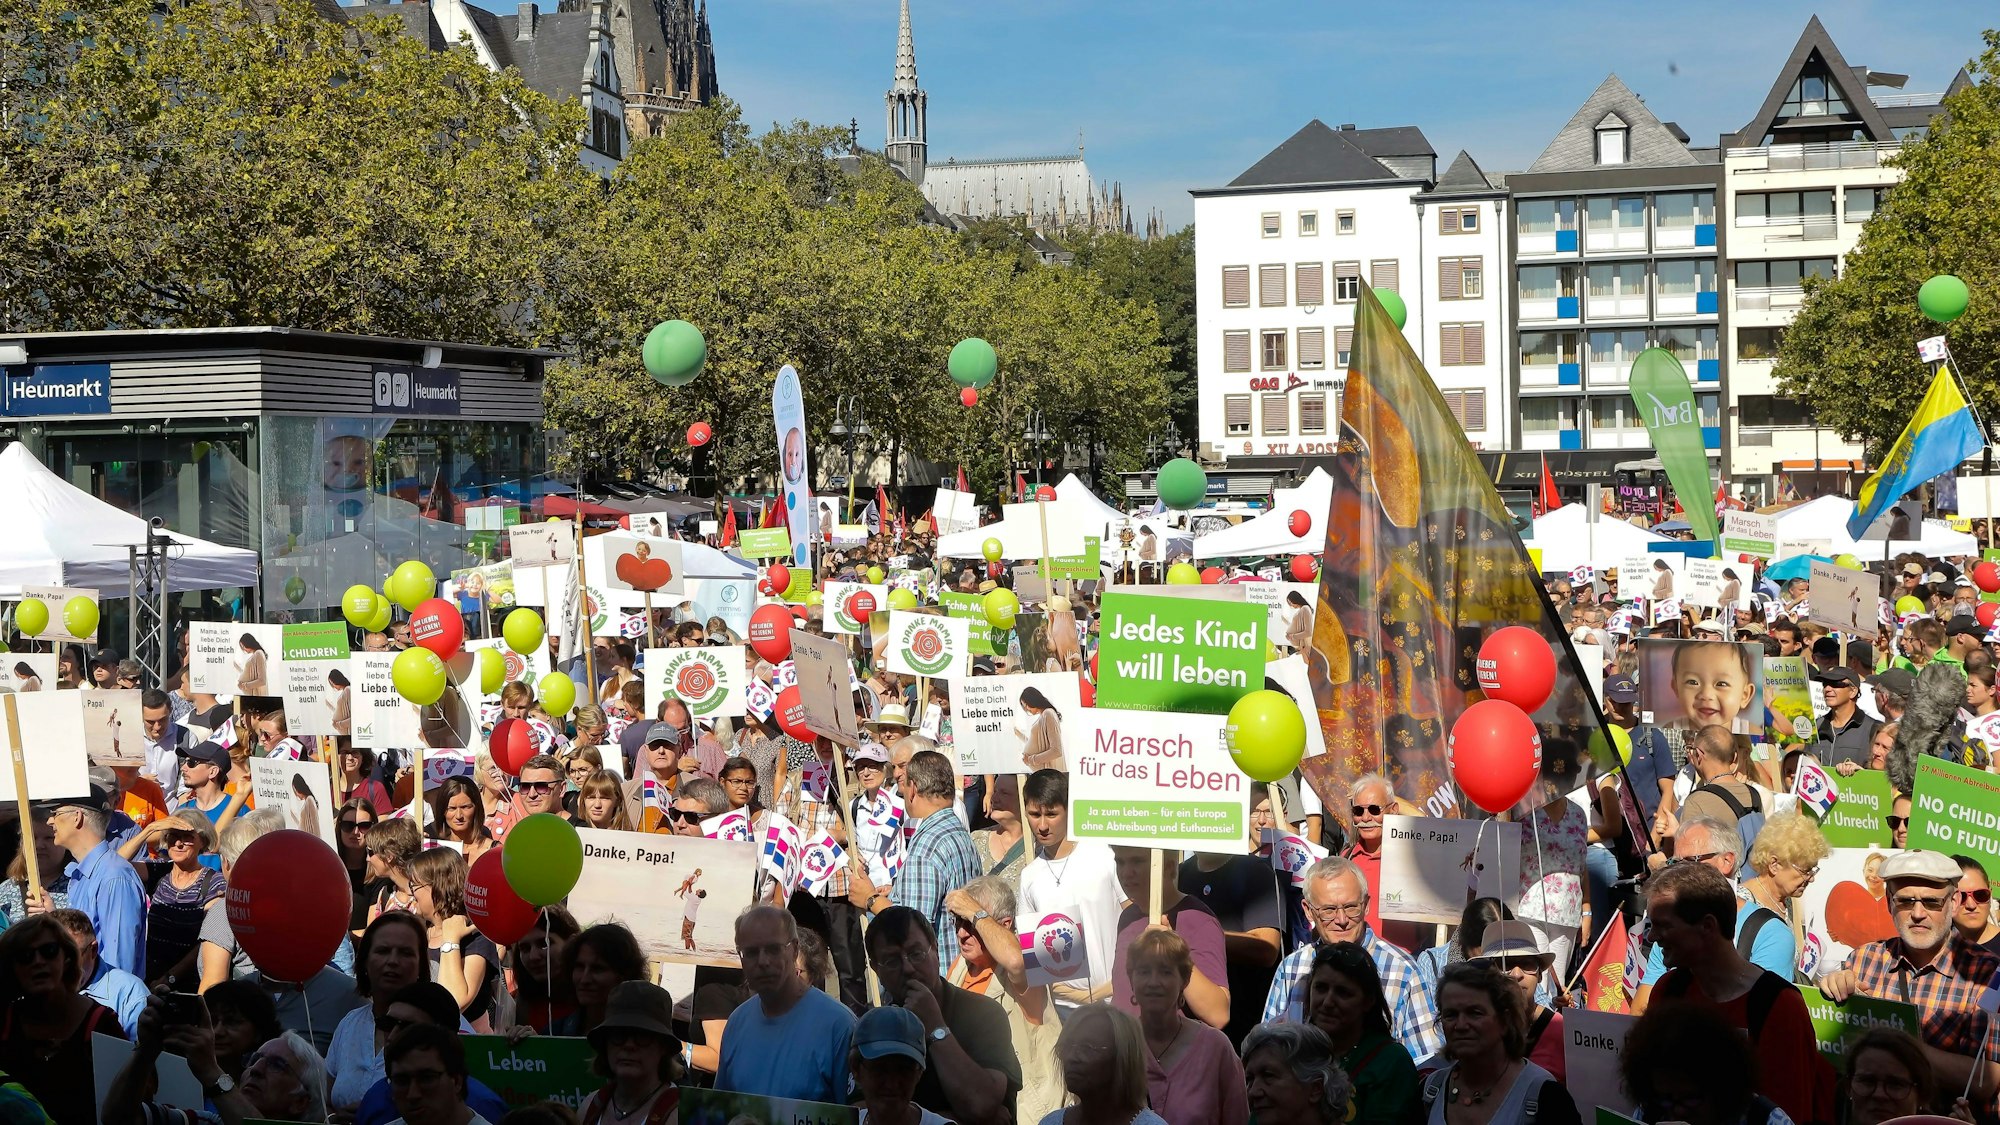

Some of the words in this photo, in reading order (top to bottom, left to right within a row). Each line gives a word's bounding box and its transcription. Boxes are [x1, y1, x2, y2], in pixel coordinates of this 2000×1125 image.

[12, 379, 103, 399] Heumarkt
[1250, 377, 1280, 391] GAG
[415, 383, 457, 400] Heumarkt
[1267, 443, 1289, 456] XII
[1551, 470, 1611, 479] POSTEL
[1731, 516, 1760, 528] Marsch
[1748, 528, 1775, 541] Leben
[1813, 568, 1831, 580] Danke,
[1832, 574, 1848, 583] Papa!
[835, 585, 854, 609] DANKE
[946, 600, 968, 611] Echte
[200, 628, 218, 636] Mama,
[902, 617, 926, 645] DANKE
[929, 618, 953, 650] MAMA!
[1110, 614, 1186, 648] Jedes
[1194, 620, 1258, 651] Kind
[197, 645, 215, 653] Liebe
[217, 646, 235, 654] mich
[289, 647, 338, 659] CHILDREN
[290, 667, 308, 675] Mama,
[365, 660, 392, 670] Mama,
[664, 651, 692, 685] DANKE
[696, 650, 728, 683] MAMA!
[1116, 652, 1164, 681] will
[1172, 654, 1247, 689] leben
[1772, 663, 1783, 673] Ich
[1785, 664, 1798, 673] bin
[366, 671, 386, 680] liebe
[288, 683, 307, 693] Liebe
[310, 683, 325, 692] mich
[361, 682, 387, 694] Liebe
[1764, 676, 1807, 689] besonders!
[963, 686, 991, 694] Mama,
[87, 699, 105, 709] Papa!
[299, 694, 318, 704] auch!
[373, 696, 400, 708] auch!
[965, 696, 984, 705] liebe
[987, 696, 1007, 704] Dich!
[961, 708, 988, 719] Liebe
[991, 707, 1015, 718] mich
[976, 722, 1002, 733] auch!
[1095, 729, 1193, 759] Marsch
[1079, 757, 1106, 777] für
[1112, 760, 1149, 780] das
[1155, 762, 1241, 792] Leben
[1930, 768, 1961, 783] Millionen
[258, 787, 275, 798] Liebe
[276, 790, 290, 800] mich
[1918, 794, 1944, 814] NO
[1088, 806, 1099, 817] Ja
[1101, 808, 1121, 817] zum
[1123, 807, 1150, 818] Leben
[1160, 808, 1174, 819] für
[1177, 808, 1191, 819] ein
[1194, 809, 1228, 822] Europa
[1834, 811, 1880, 831] Unrecht
[1081, 822, 1104, 832] ohne
[1106, 822, 1158, 836] Abtreibung
[1161, 823, 1178, 833] und
[1180, 823, 1236, 835] Euthanasie!
[1926, 821, 1952, 841] NO
[1391, 828, 1425, 841] Danke,
[1429, 831, 1459, 845] Papa!
[584, 844, 631, 863] Danke,
[636, 848, 664, 866] Papa!
[1574, 1030, 1620, 1055] Danke,
[487, 1050, 547, 1073] Leben
